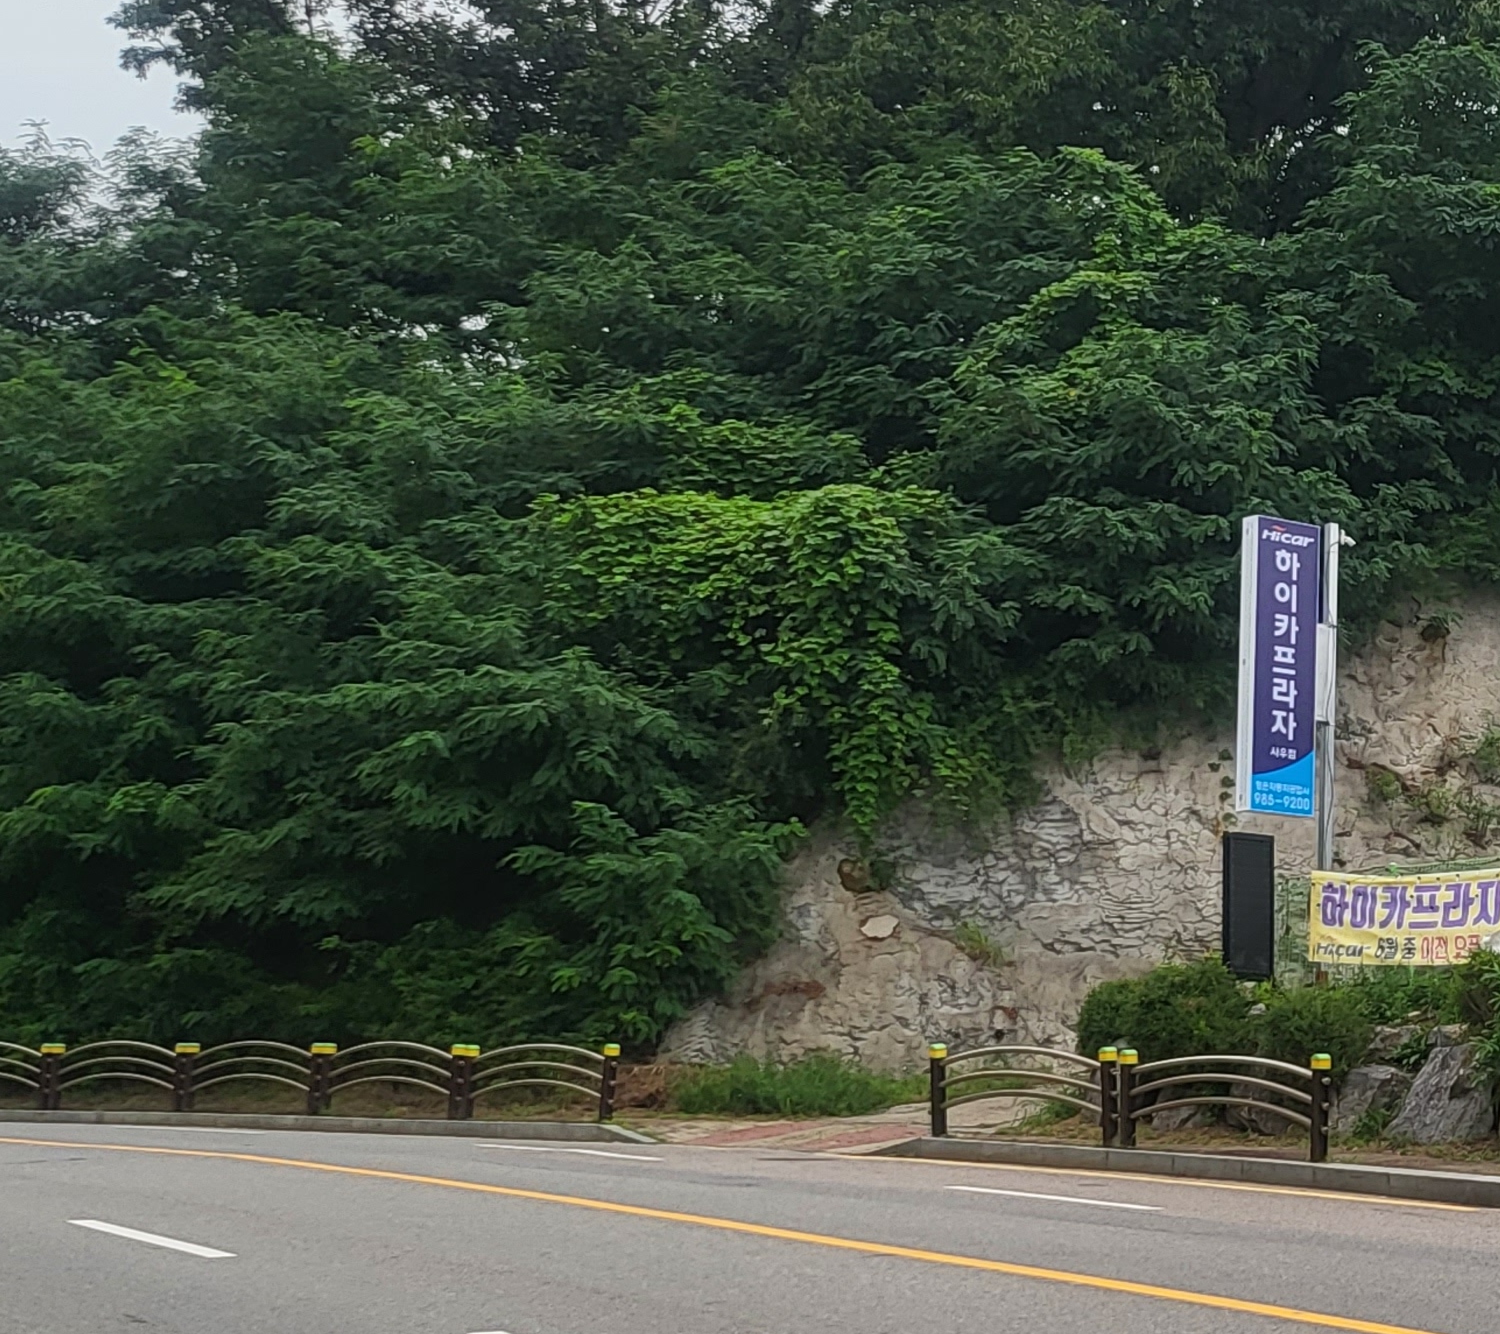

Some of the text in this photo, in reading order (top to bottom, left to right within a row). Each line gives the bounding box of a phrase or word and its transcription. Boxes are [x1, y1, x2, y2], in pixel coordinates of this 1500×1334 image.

[1261, 527, 1316, 548] Hicar
[1270, 549, 1301, 742] 하이카프라자
[1270, 747, 1297, 760] 사우점
[1254, 792, 1310, 810] 985-9200
[1374, 936, 1399, 959] 6월
[1401, 936, 1417, 959] 중
[1421, 935, 1449, 959] 이전
